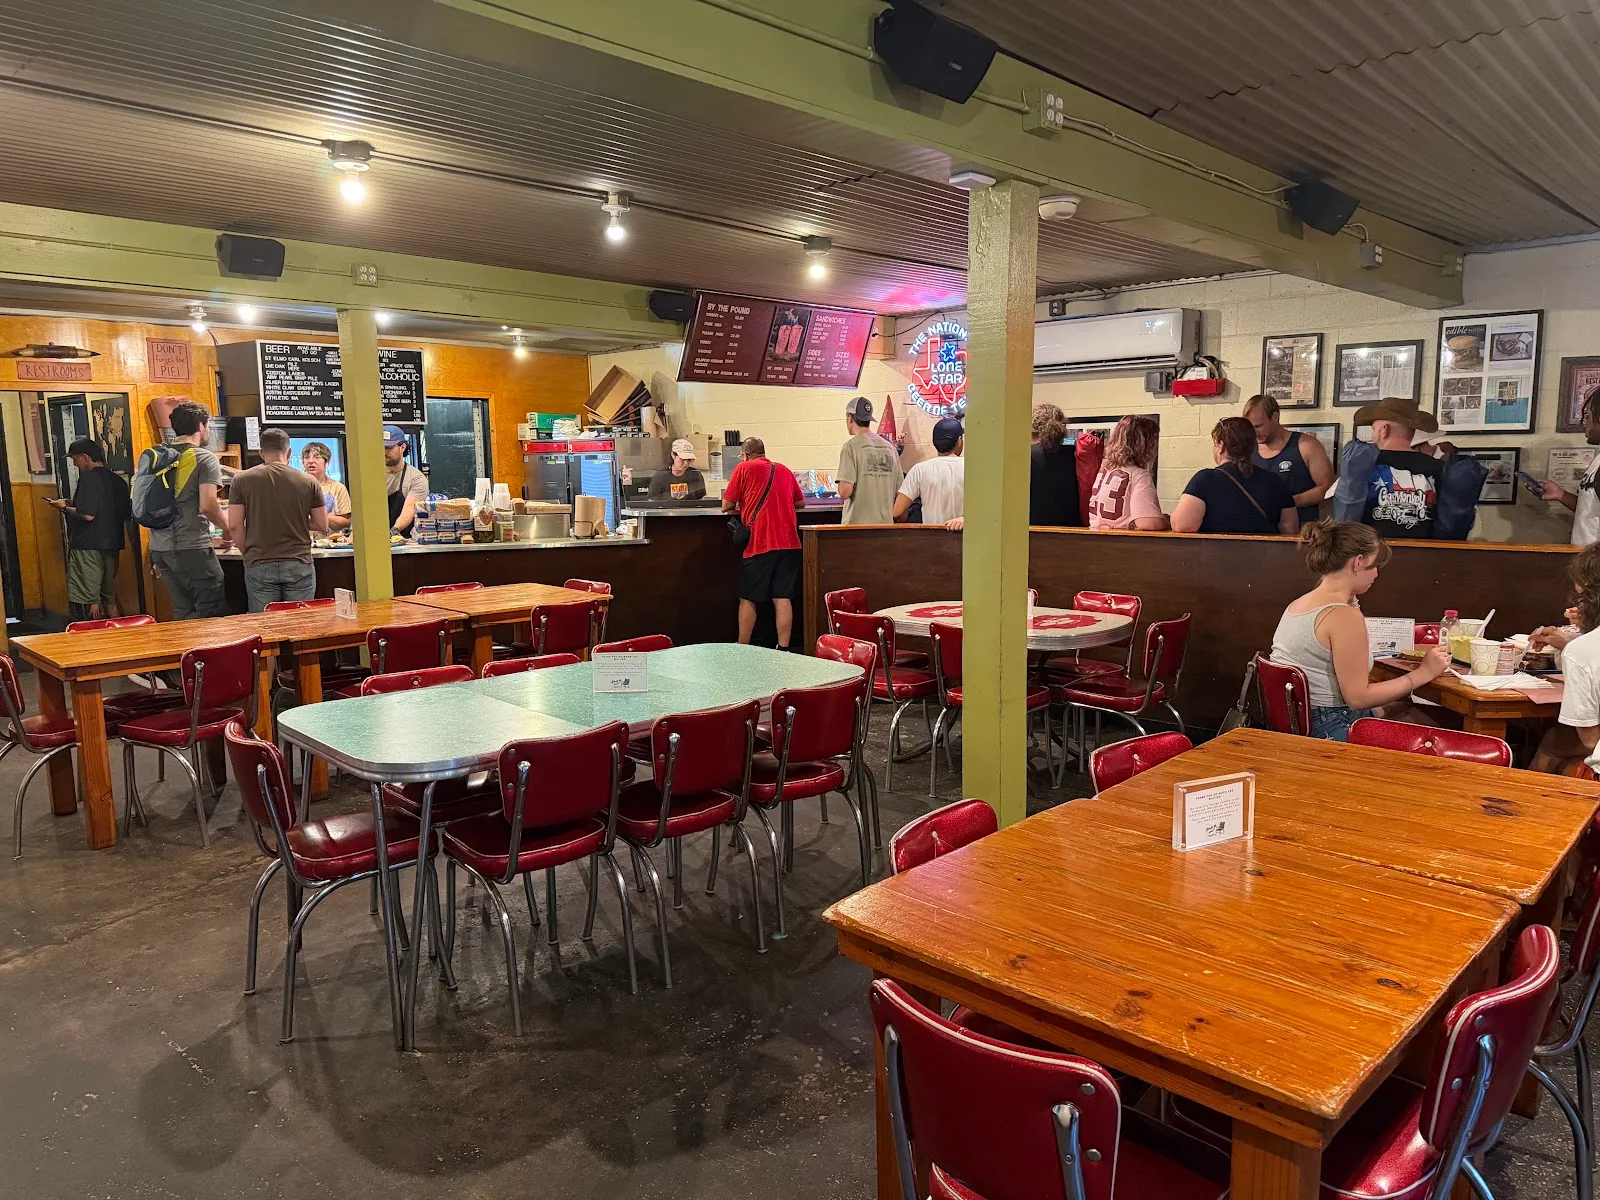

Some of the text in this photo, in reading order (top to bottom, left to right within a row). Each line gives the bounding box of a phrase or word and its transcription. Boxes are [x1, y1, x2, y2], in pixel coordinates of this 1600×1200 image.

[730, 306, 750, 314] POUND
[1446, 326, 1467, 334] edible
[909, 322, 968, 355] THE NATION
[156, 343, 183, 353] DON'T
[265, 345, 290, 354] BEER
[26, 364, 84, 378] RESTROOMS
[930, 361, 962, 372] LONE
[931, 374, 962, 384] STAR
[1089, 469, 1130, 520] 23
